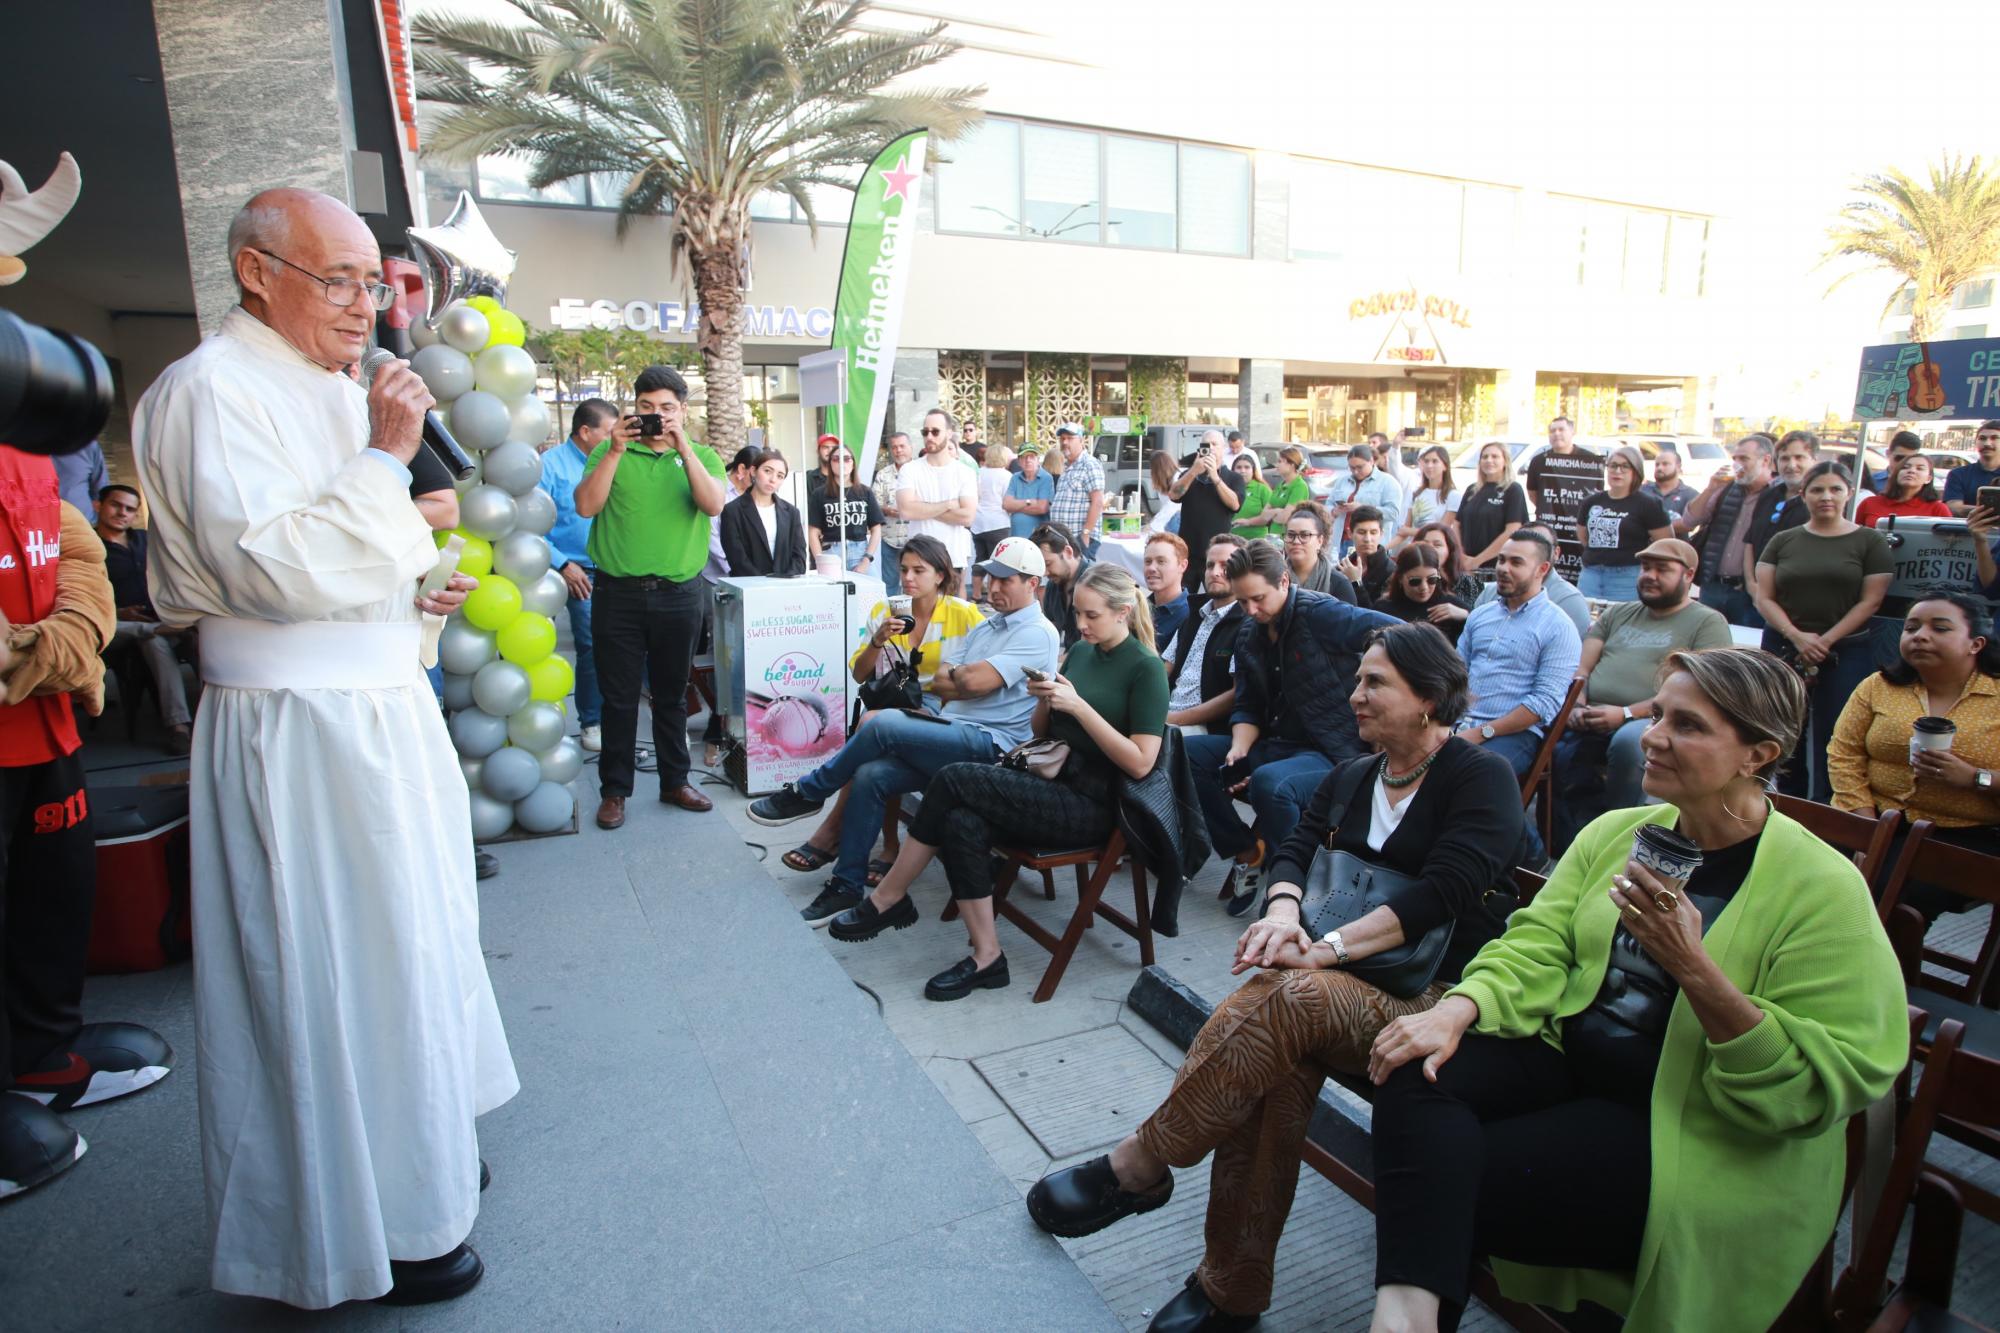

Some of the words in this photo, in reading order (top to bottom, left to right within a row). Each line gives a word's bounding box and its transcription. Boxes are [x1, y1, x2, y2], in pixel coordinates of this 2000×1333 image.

[855, 216, 901, 371] Heineken
[557, 298, 833, 338] ECOFAMAC
[824, 501, 868, 515] DIRTY
[825, 512, 867, 528] SCOOP
[1917, 548, 1977, 560] CERVECERI
[1894, 559, 1943, 580] TRES
[1947, 560, 1976, 582] ISL
[785, 614, 815, 626] SUGAR
[746, 627, 777, 639] SWEET
[779, 625, 815, 636] ENOUGH
[764, 663, 825, 686] beyond
[790, 679, 815, 687] sugar
[34, 788, 88, 833] 911
